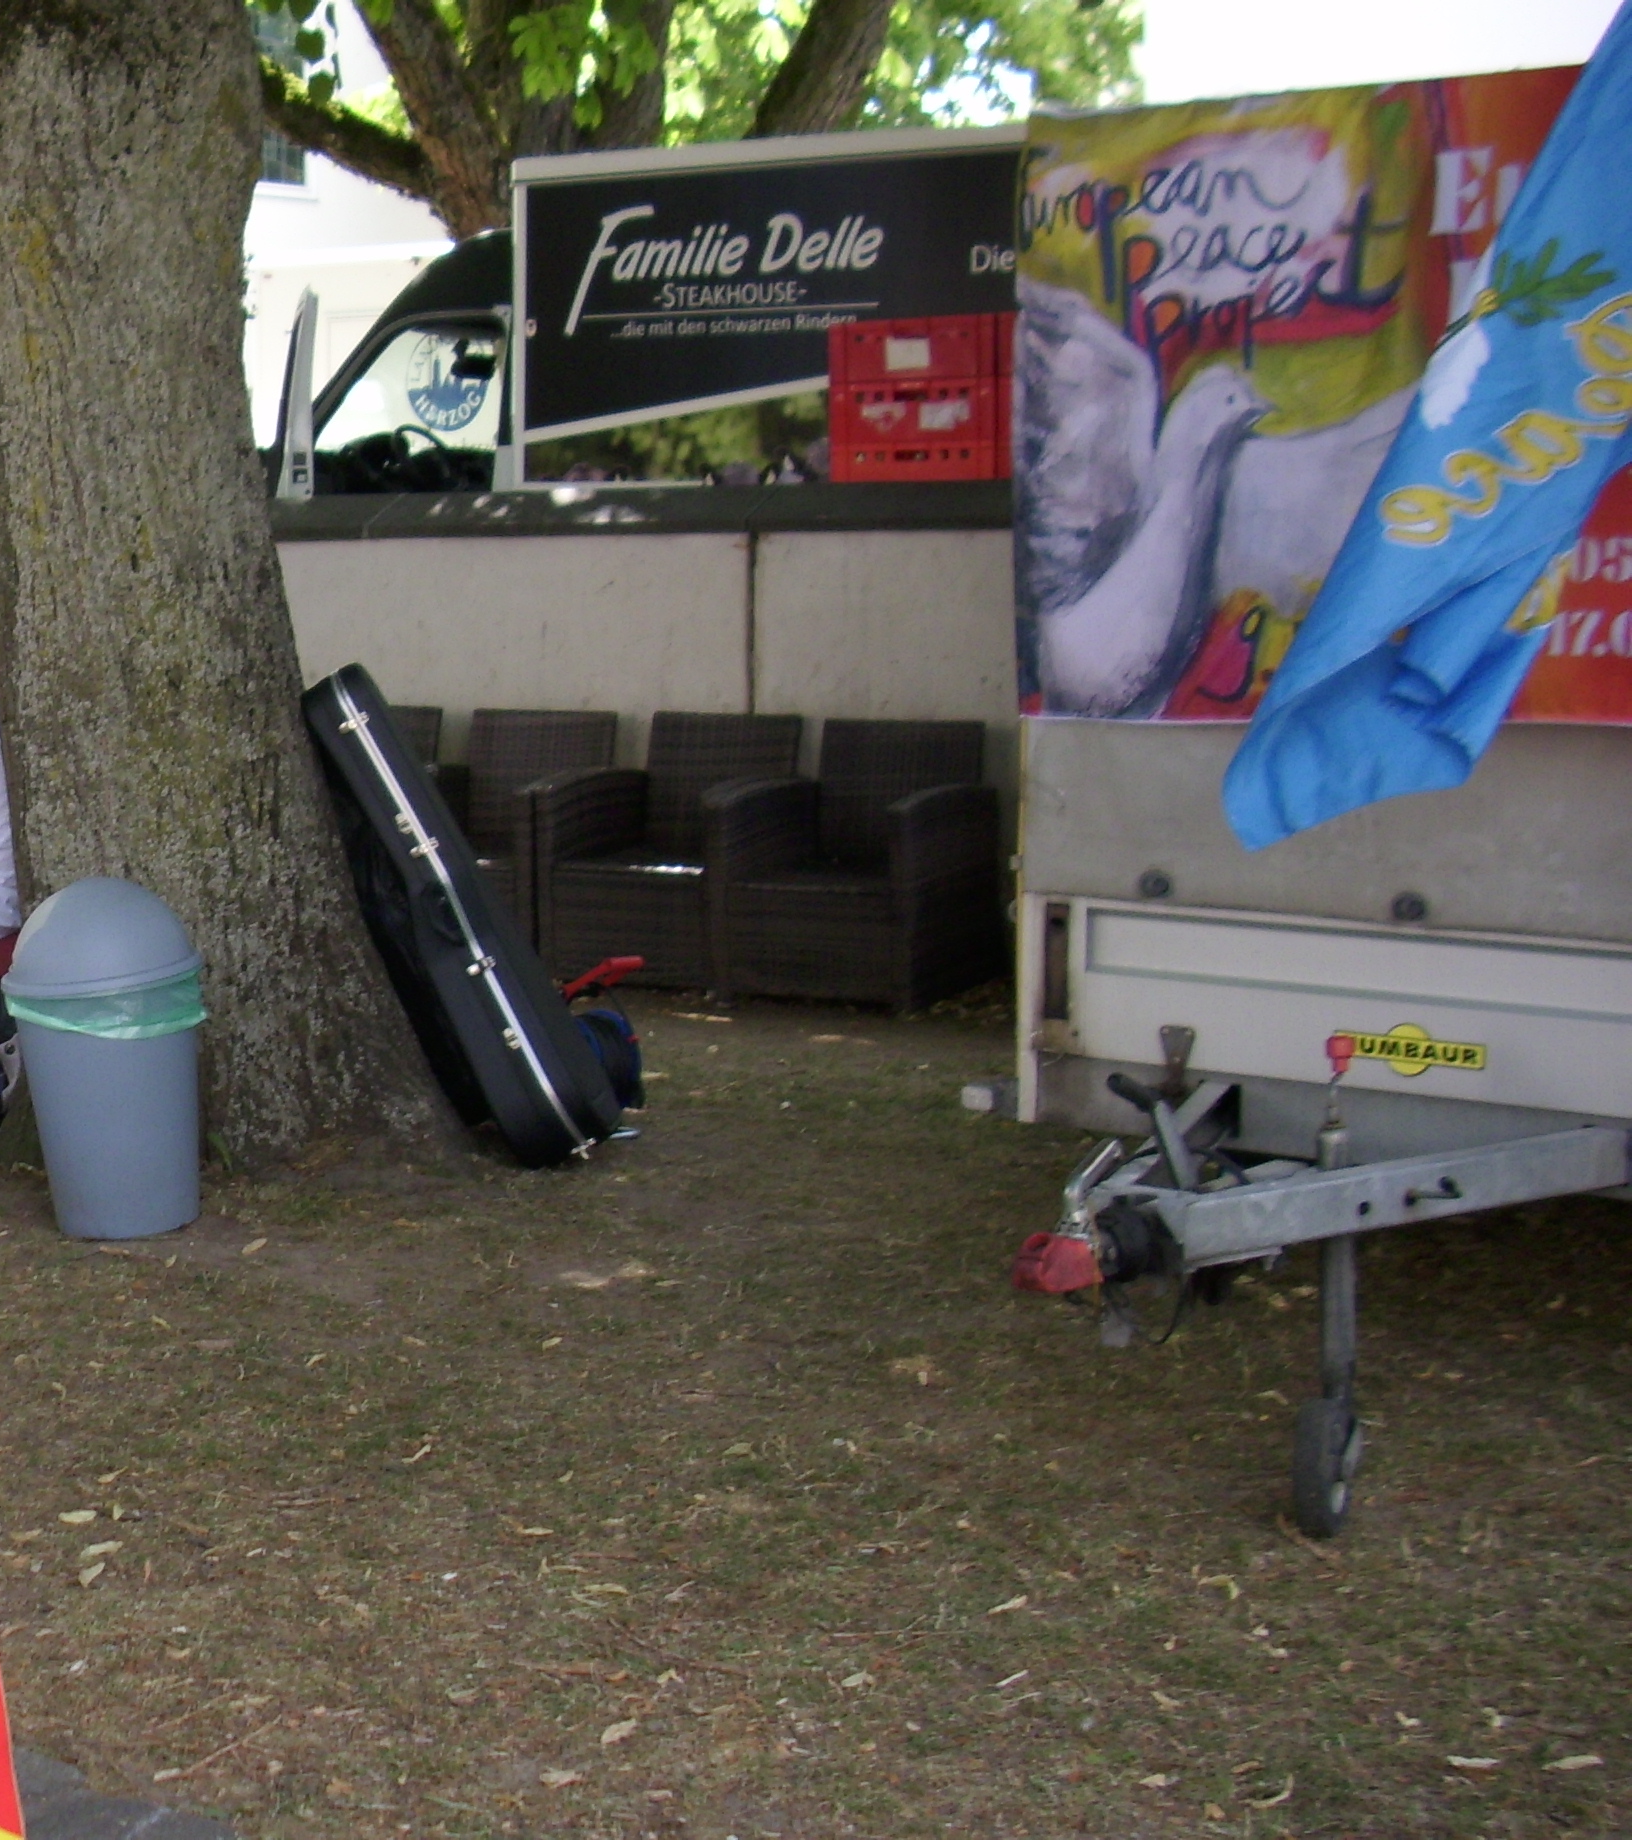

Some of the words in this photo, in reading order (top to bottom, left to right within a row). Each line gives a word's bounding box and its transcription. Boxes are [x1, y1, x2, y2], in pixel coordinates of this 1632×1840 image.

[565, 205, 749, 336] Familie
[759, 212, 885, 273] Delle
[971, 244, 1016, 273] Die
[1122, 223, 1308, 342] Peace
[649, 319, 674, 336] mit
[677, 318, 706, 335] den
[710, 315, 791, 333] schwarzen
[415, 391, 482, 426] HERZOG
[1357, 1036, 1480, 1065] UMBAUR
